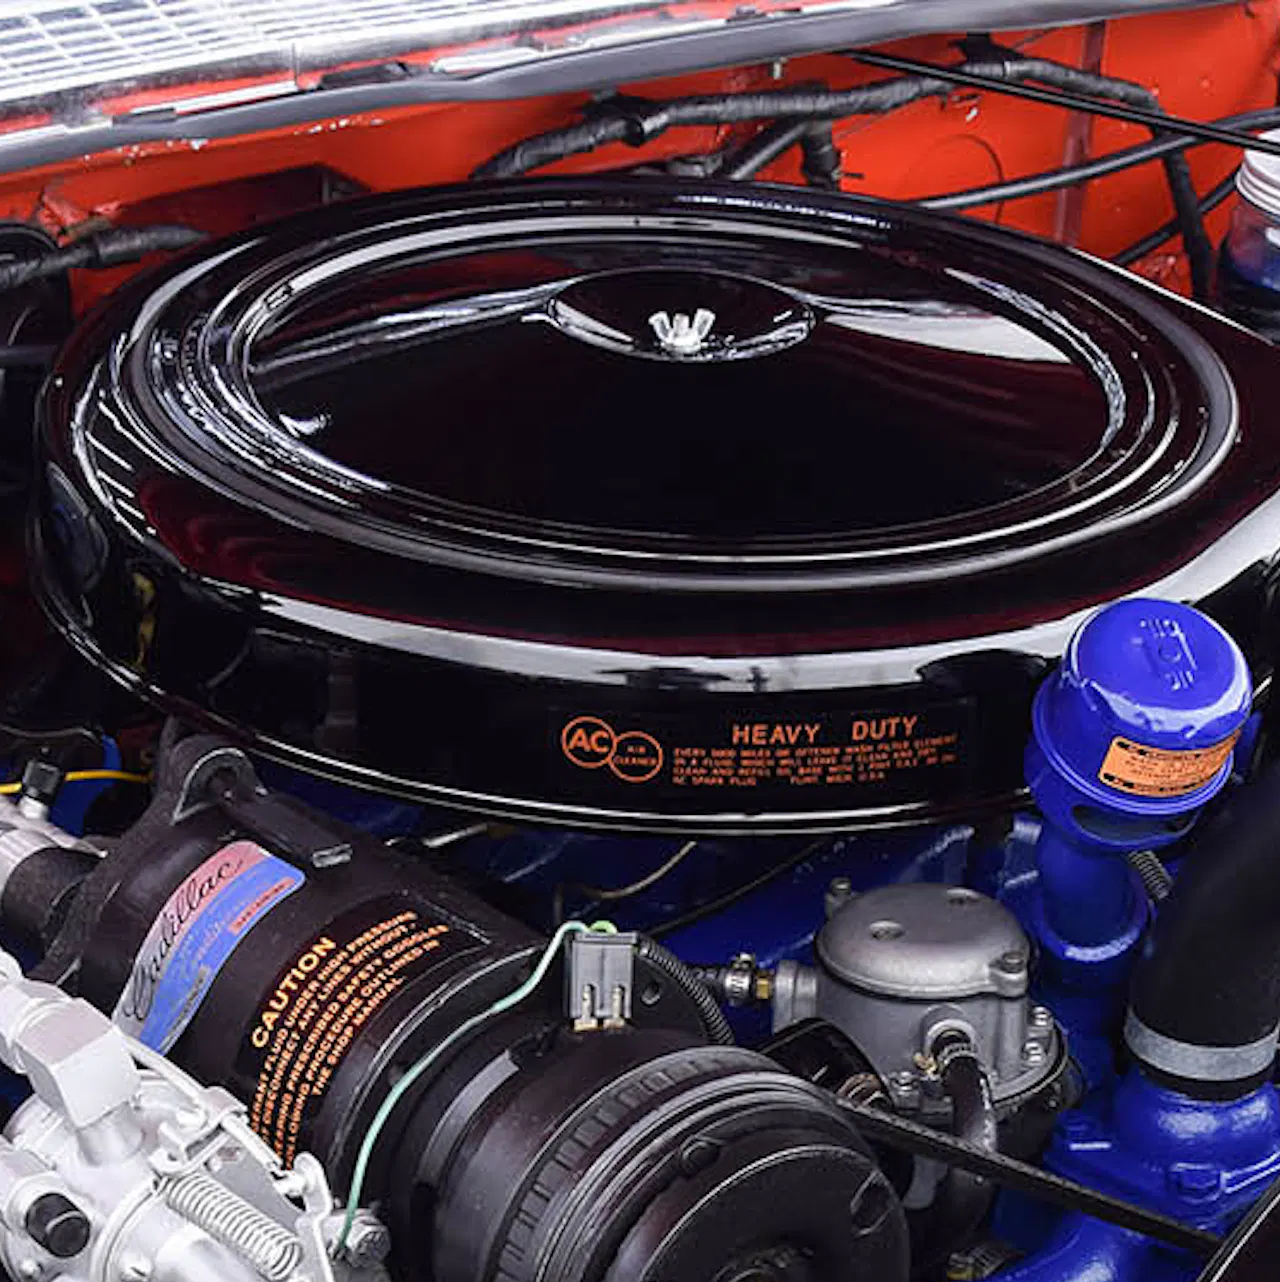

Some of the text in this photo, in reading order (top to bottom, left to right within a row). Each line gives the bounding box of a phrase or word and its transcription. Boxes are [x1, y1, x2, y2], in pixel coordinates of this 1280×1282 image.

[568, 728, 610, 754] AC
[732, 715, 919, 746] HEAVY DUTY
[122, 857, 244, 1022] Cadillac
[254, 934, 337, 1047] CAUTION
[284, 977, 320, 1029] UNDER
[315, 949, 349, 982] HIGH
[287, 999, 342, 1091] PRESCRIBED
[335, 957, 382, 1003] SAFETY
[296, 999, 321, 1030] ANY
[316, 961, 353, 1002] LINES
[304, 994, 364, 1081] PROCEDURE
[312, 1066, 333, 1097] THE
[327, 1024, 355, 1067] SHOP
